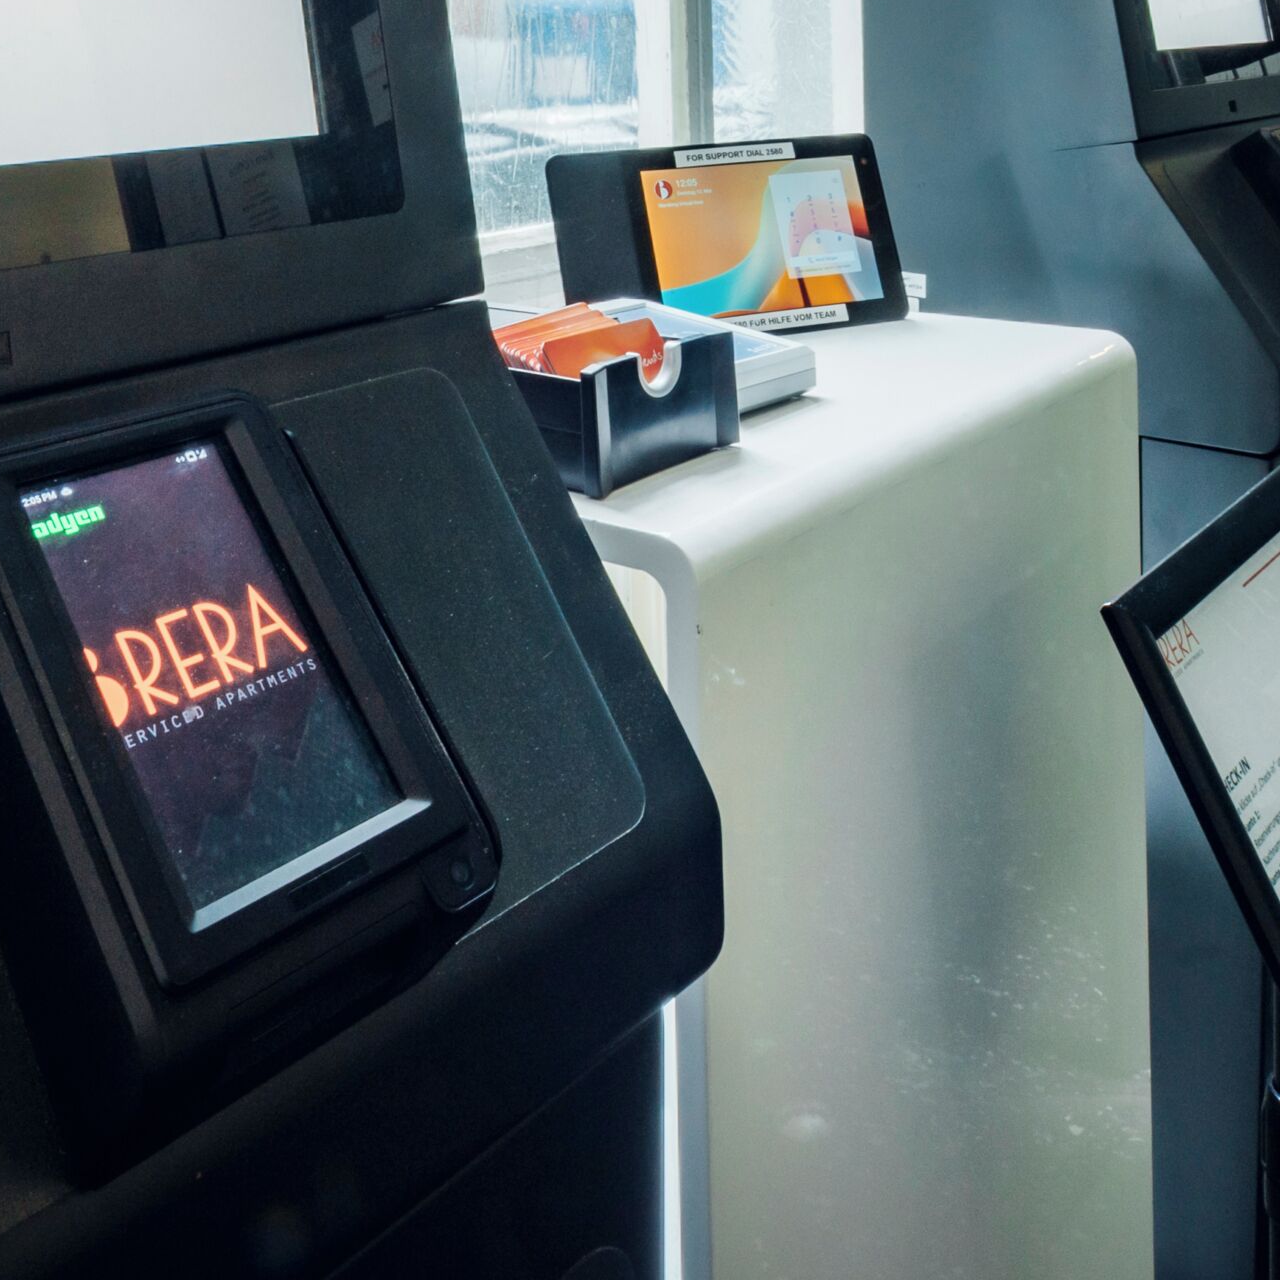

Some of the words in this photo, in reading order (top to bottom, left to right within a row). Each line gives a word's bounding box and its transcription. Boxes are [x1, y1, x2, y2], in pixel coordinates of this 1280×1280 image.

[686, 152, 704, 162] FOR
[706, 150, 744, 161] SUPPORT
[746, 148, 765, 158] DIAL
[768, 315, 793, 324] HILFE
[793, 312, 812, 321] VOM
[814, 310, 837, 319] TEAM
[22, 494, 41, 507] 2:05
[42, 490, 58, 503] PM
[31, 504, 106, 539] adyen
[82, 582, 308, 728] BRERA
[1156, 618, 1200, 668] RERA
[124, 705, 205, 749] ERVICED
[216, 658, 318, 710] APARTMENTS
[1223, 756, 1251, 793] HECK-IN
